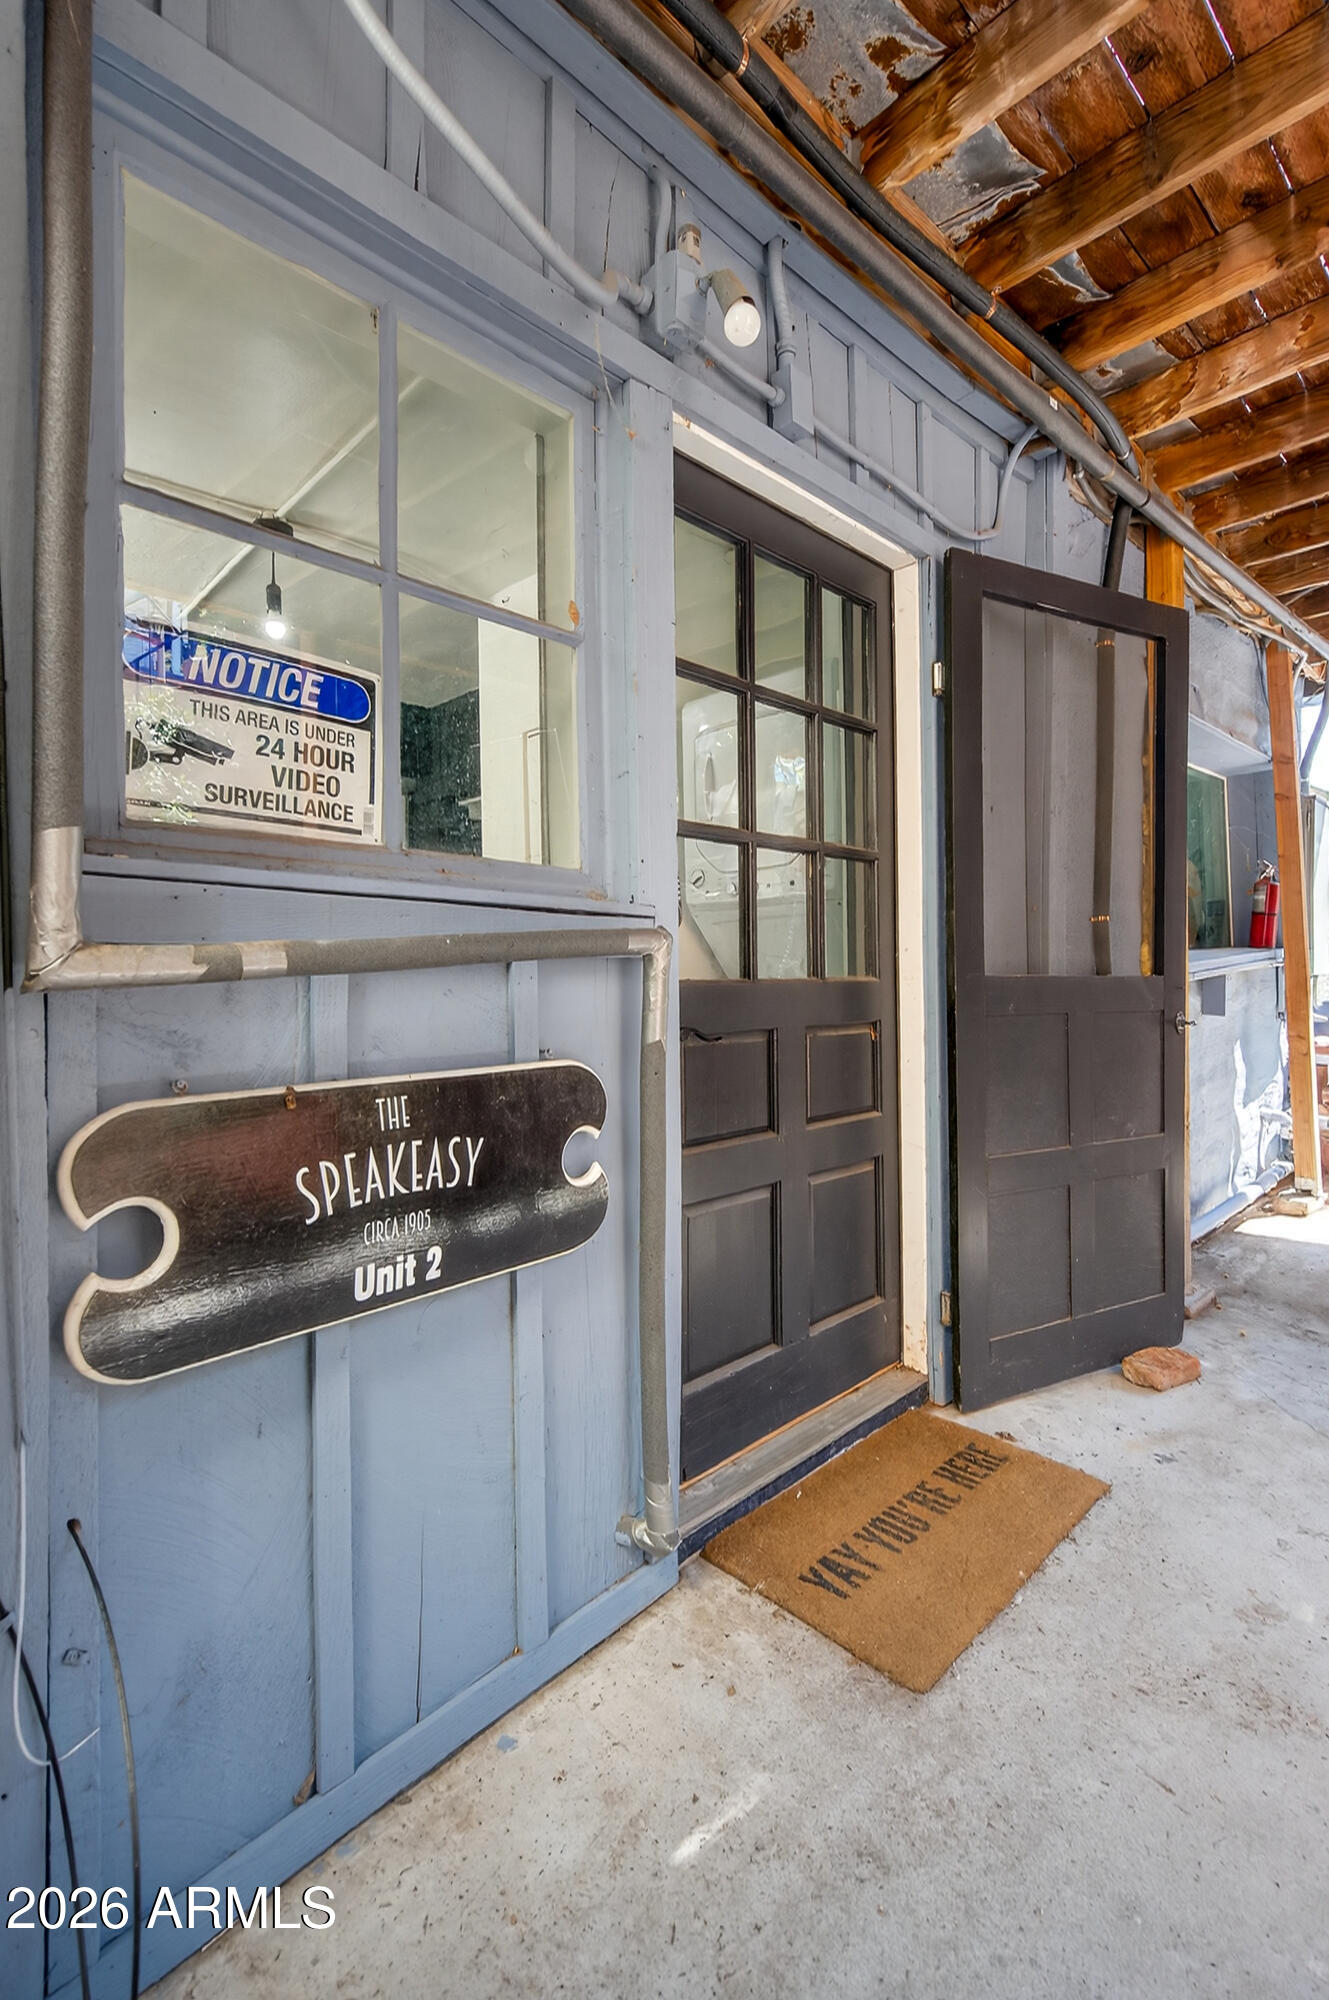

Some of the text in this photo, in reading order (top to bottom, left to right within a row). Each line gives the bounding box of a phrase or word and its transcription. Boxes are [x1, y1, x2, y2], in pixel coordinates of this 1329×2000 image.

[188, 645, 324, 709] NOTICE
[190, 699, 355, 748] THIS AREA IS UNDER
[255, 735, 355, 773] 24 HOUR
[204, 783, 354, 823] SURVEILLANCE
[271, 764, 341, 798] VIDEO
[375, 1095, 411, 1132] THE
[295, 1136, 484, 1226] SPEAKEASY
[363, 1208, 432, 1246] CIRCA 1905
[354, 1244, 443, 1302] Unit 2
[798, 1442, 1009, 1599] YAY YOU'RE HERE
